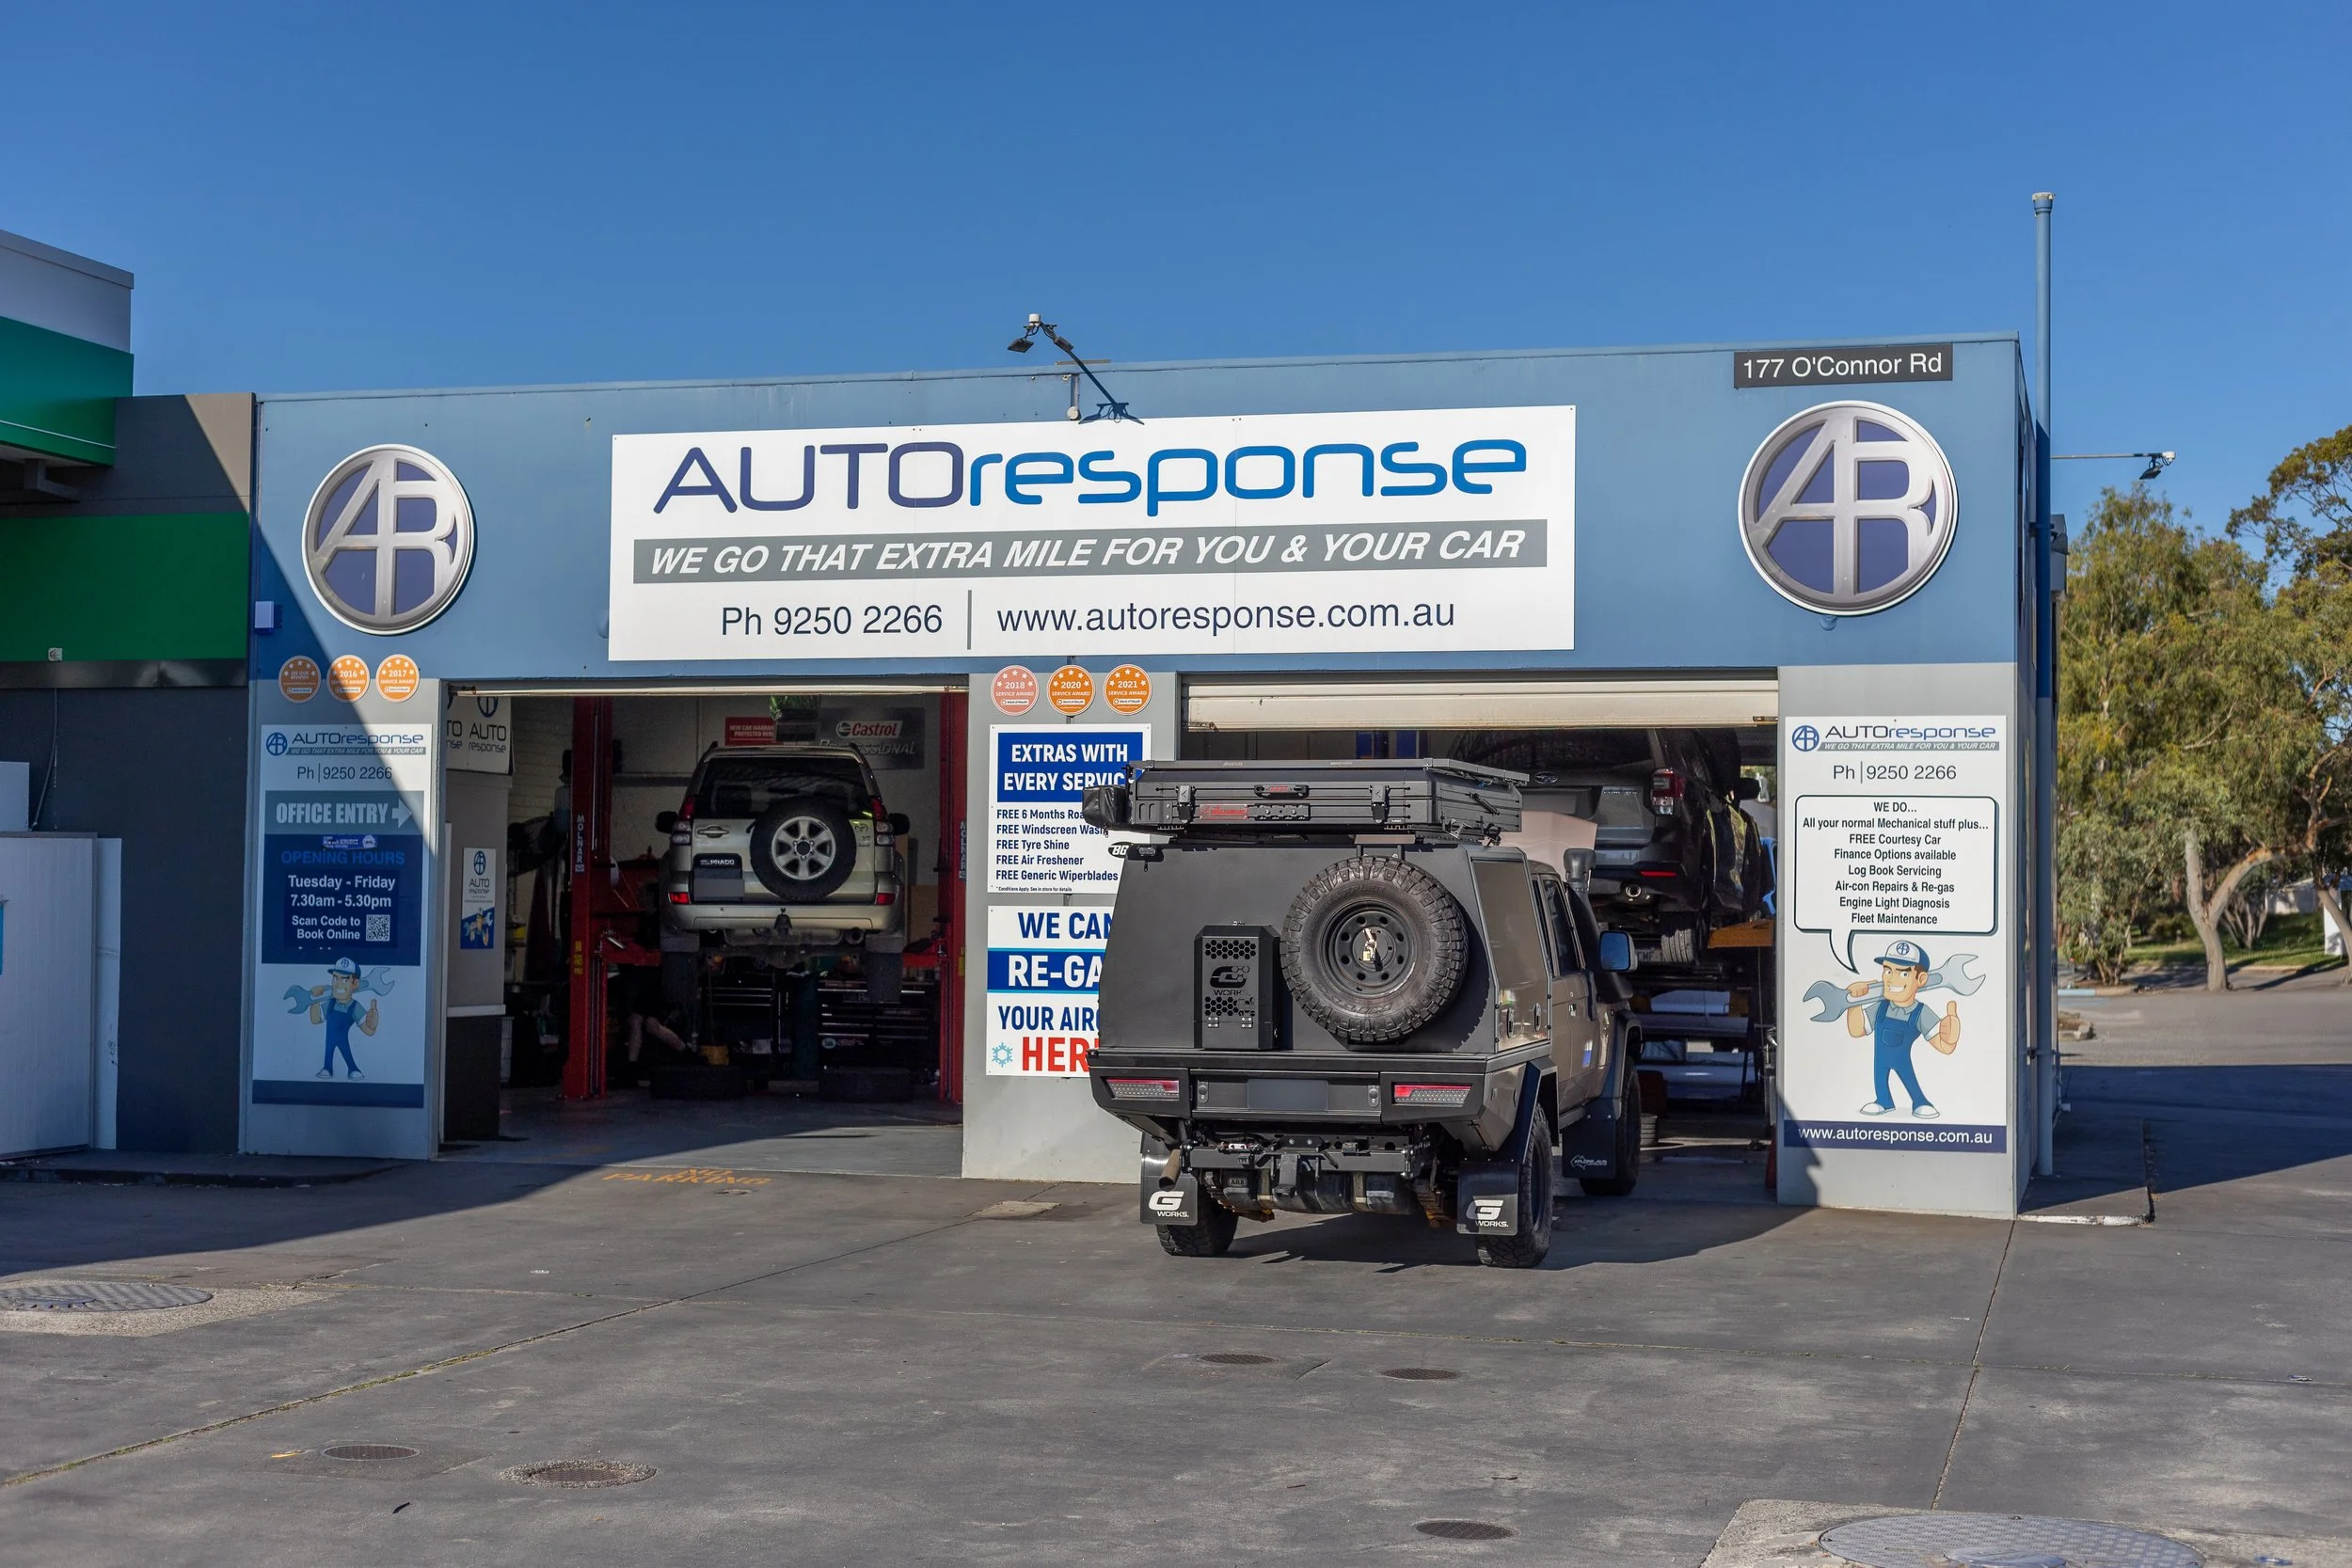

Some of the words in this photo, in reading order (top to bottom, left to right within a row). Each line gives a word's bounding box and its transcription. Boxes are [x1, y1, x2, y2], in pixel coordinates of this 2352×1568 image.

[1743, 358, 1785, 378] 177
[1791, 355, 1901, 377] O'Connor
[1909, 353, 1942, 373] Rd
[653, 438, 1527, 517] AUTOresponse
[651, 546, 707, 575] WE
[713, 545, 770, 574] GO
[779, 544, 873, 572] THAT
[876, 541, 993, 570] EXTRA
[1003, 538, 1097, 568] MILE
[1101, 537, 1184, 566] FOR
[1194, 535, 1276, 564] YOU
[1280, 534, 1308, 562] &
[1322, 531, 1425, 562] YOUR
[1438, 530, 1526, 559] CAR
[722, 607, 761, 635] Ph
[773, 606, 851, 635] 9250
[863, 604, 943, 634] 2266
[997, 602, 1454, 637] www.autoresponse.com.au
[1005, 681, 1025, 689] 2018
[1061, 681, 1081, 689] 2020
[1118, 680, 1137, 689] 2021
[469, 722, 507, 741] AUTO
[852, 722, 898, 737] Castrol
[1825, 725, 1995, 740] AUTOresponse
[292, 733, 423, 747] AUTOresponse
[469, 741, 507, 753] response
[1011, 744, 1077, 762] EXTRAS
[1081, 744, 1128, 762] WITH
[297, 767, 314, 779] Ph
[323, 767, 356, 779] 9250
[359, 767, 392, 779] 2266
[1834, 765, 1855, 779] Ph
[1867, 765, 1909, 779] 9250
[1914, 765, 1957, 779] 2266
[1004, 773, 1058, 791] EVERY
[1062, 773, 1135, 791] SERVIC
[276, 802, 332, 824] OFFICE
[336, 802, 389, 824] ENTRY
[996, 810, 1019, 819] FREE
[1022, 810, 1027, 819] 6
[1029, 810, 1065, 819] Months
[1873, 801, 1890, 812] WE
[1892, 802, 1917, 813] DO...
[996, 825, 1019, 834] FREE
[1022, 825, 1077, 834] Windscreen
[1803, 817, 1816, 828] All
[1818, 819, 1839, 831] your
[1841, 818, 1875, 828] normal
[1877, 818, 1931, 829] Mechanical
[1933, 818, 1955, 829] stuff
[1958, 818, 1989, 832] plus...
[996, 840, 1019, 849] FREE
[1021, 840, 1041, 851] Tyre
[1043, 840, 1070, 850] Shine
[1849, 833, 1876, 844] FREE
[1878, 834, 1922, 847] Courtesy
[1924, 834, 1941, 845] Car
[281, 850, 347, 865] OPENING
[352, 850, 405, 865] HOURS
[996, 855, 1019, 864] FREE
[1021, 855, 1035, 864] Air
[1037, 855, 1085, 865] Freshener
[1834, 848, 1871, 859] Finance
[1874, 849, 1912, 862] Options
[1915, 849, 1956, 860] available
[995, 870, 1019, 879] FREE
[1021, 870, 1057, 880] Generic
[1059, 870, 1119, 883] Wiperblades
[1848, 865, 1867, 878] Log
[1869, 865, 1894, 876] Book
[1897, 865, 1942, 878] Servicing
[288, 875, 342, 891] Tuesday
[355, 875, 396, 891] Friday
[469, 878, 489, 887] AUTO
[1835, 880, 1869, 891] Air-con
[1872, 881, 1908, 894] Repairs
[1911, 881, 1918, 892] &
[1921, 882, 1955, 895] Re-gas
[291, 895, 335, 907] 7.30am
[344, 895, 391, 909] 5.30pm
[1839, 896, 1872, 909] Engine
[1875, 897, 1899, 910] Light
[1902, 897, 1950, 911] Diagnosis
[292, 915, 317, 926] Scan
[321, 915, 347, 926] Code
[350, 916, 360, 926] to
[1018, 912, 1060, 939] WE
[1851, 913, 1874, 924] Fleet
[1877, 913, 1938, 925] Maintenance
[296, 928, 324, 939] Book
[326, 928, 360, 940] Online
[1008, 955, 1104, 988] RE-GA
[998, 1006, 1054, 1031] YOUR
[1059, 1006, 1099, 1032] AIR
[1022, 1037, 1099, 1072] HER
[1798, 1127, 1993, 1144] www.autoresponse.com.au
[1149, 1191, 1184, 1211] G
